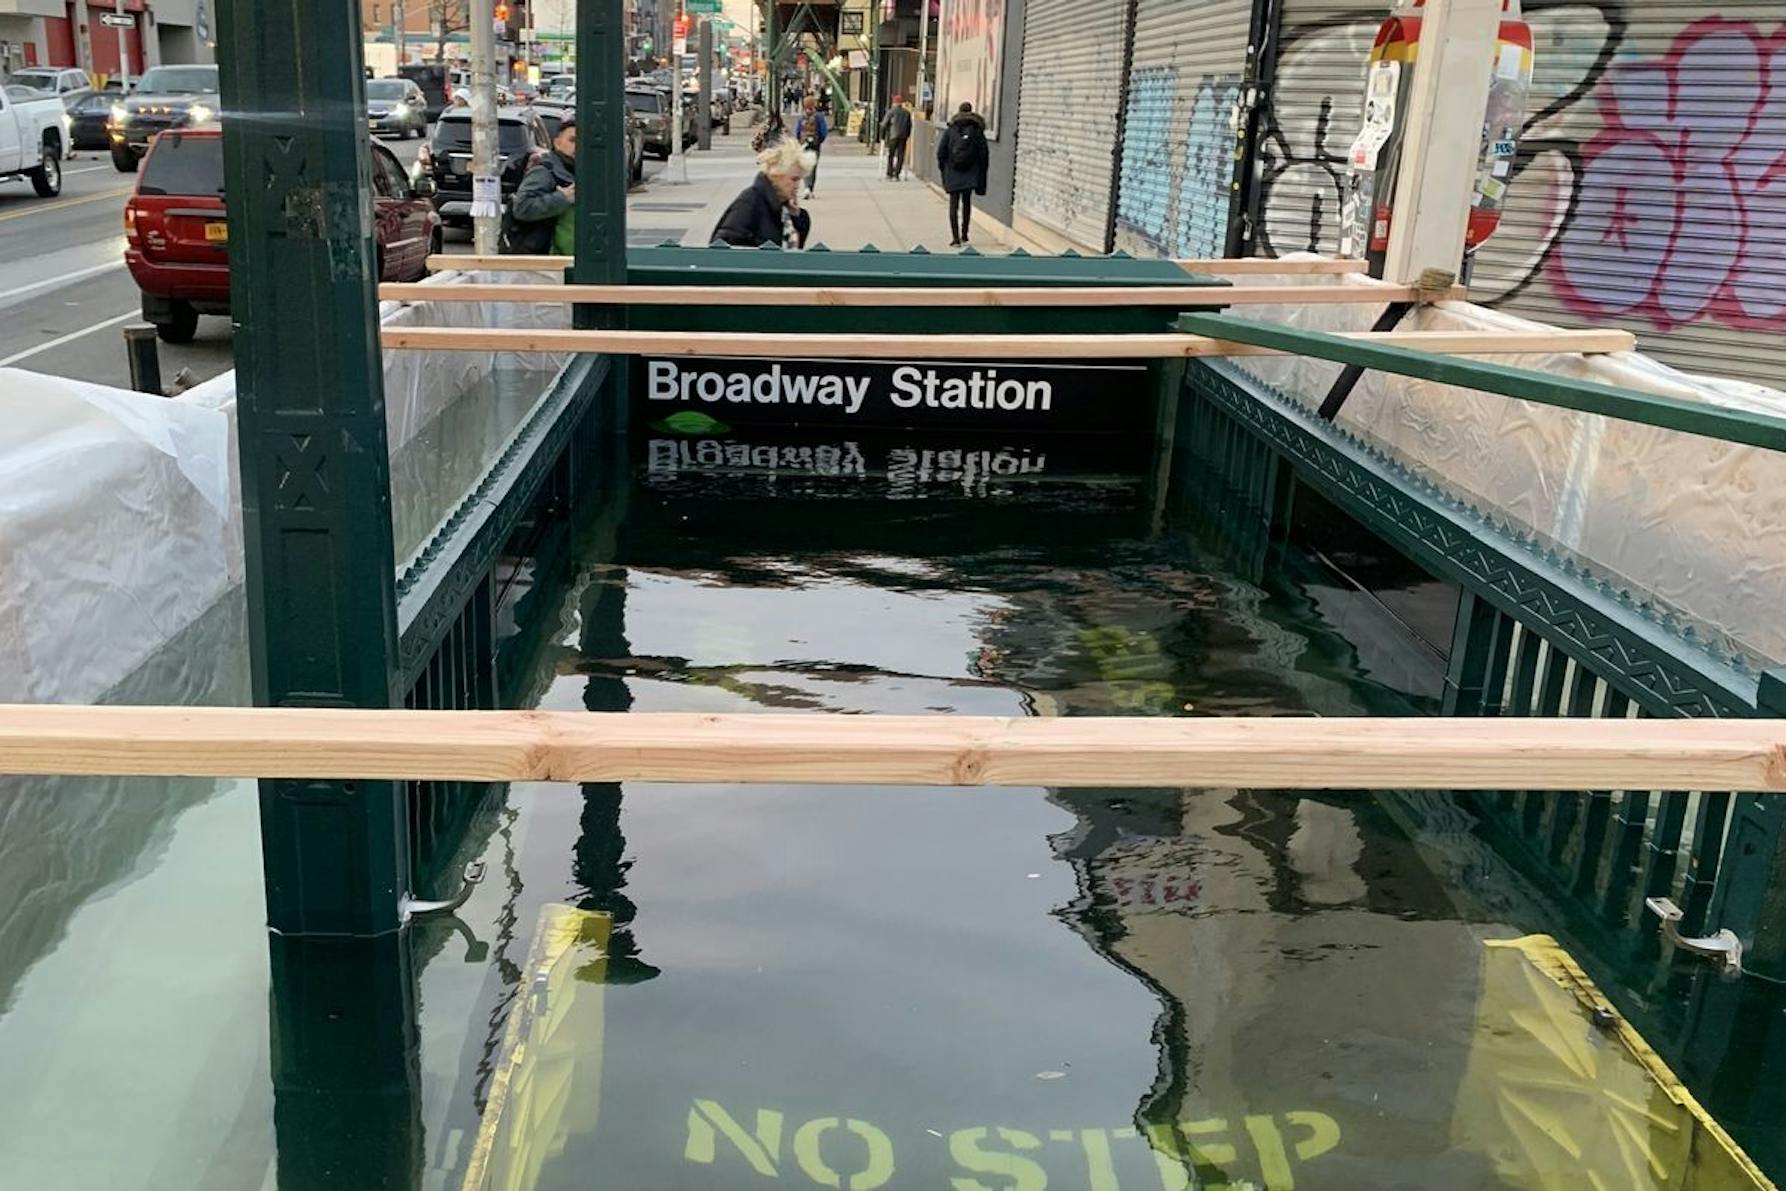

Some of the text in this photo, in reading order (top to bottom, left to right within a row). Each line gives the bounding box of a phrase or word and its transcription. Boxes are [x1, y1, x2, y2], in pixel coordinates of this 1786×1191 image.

[647, 360, 1053, 414] Broadway Station
[684, 1098, 1342, 1191] NO STEP
